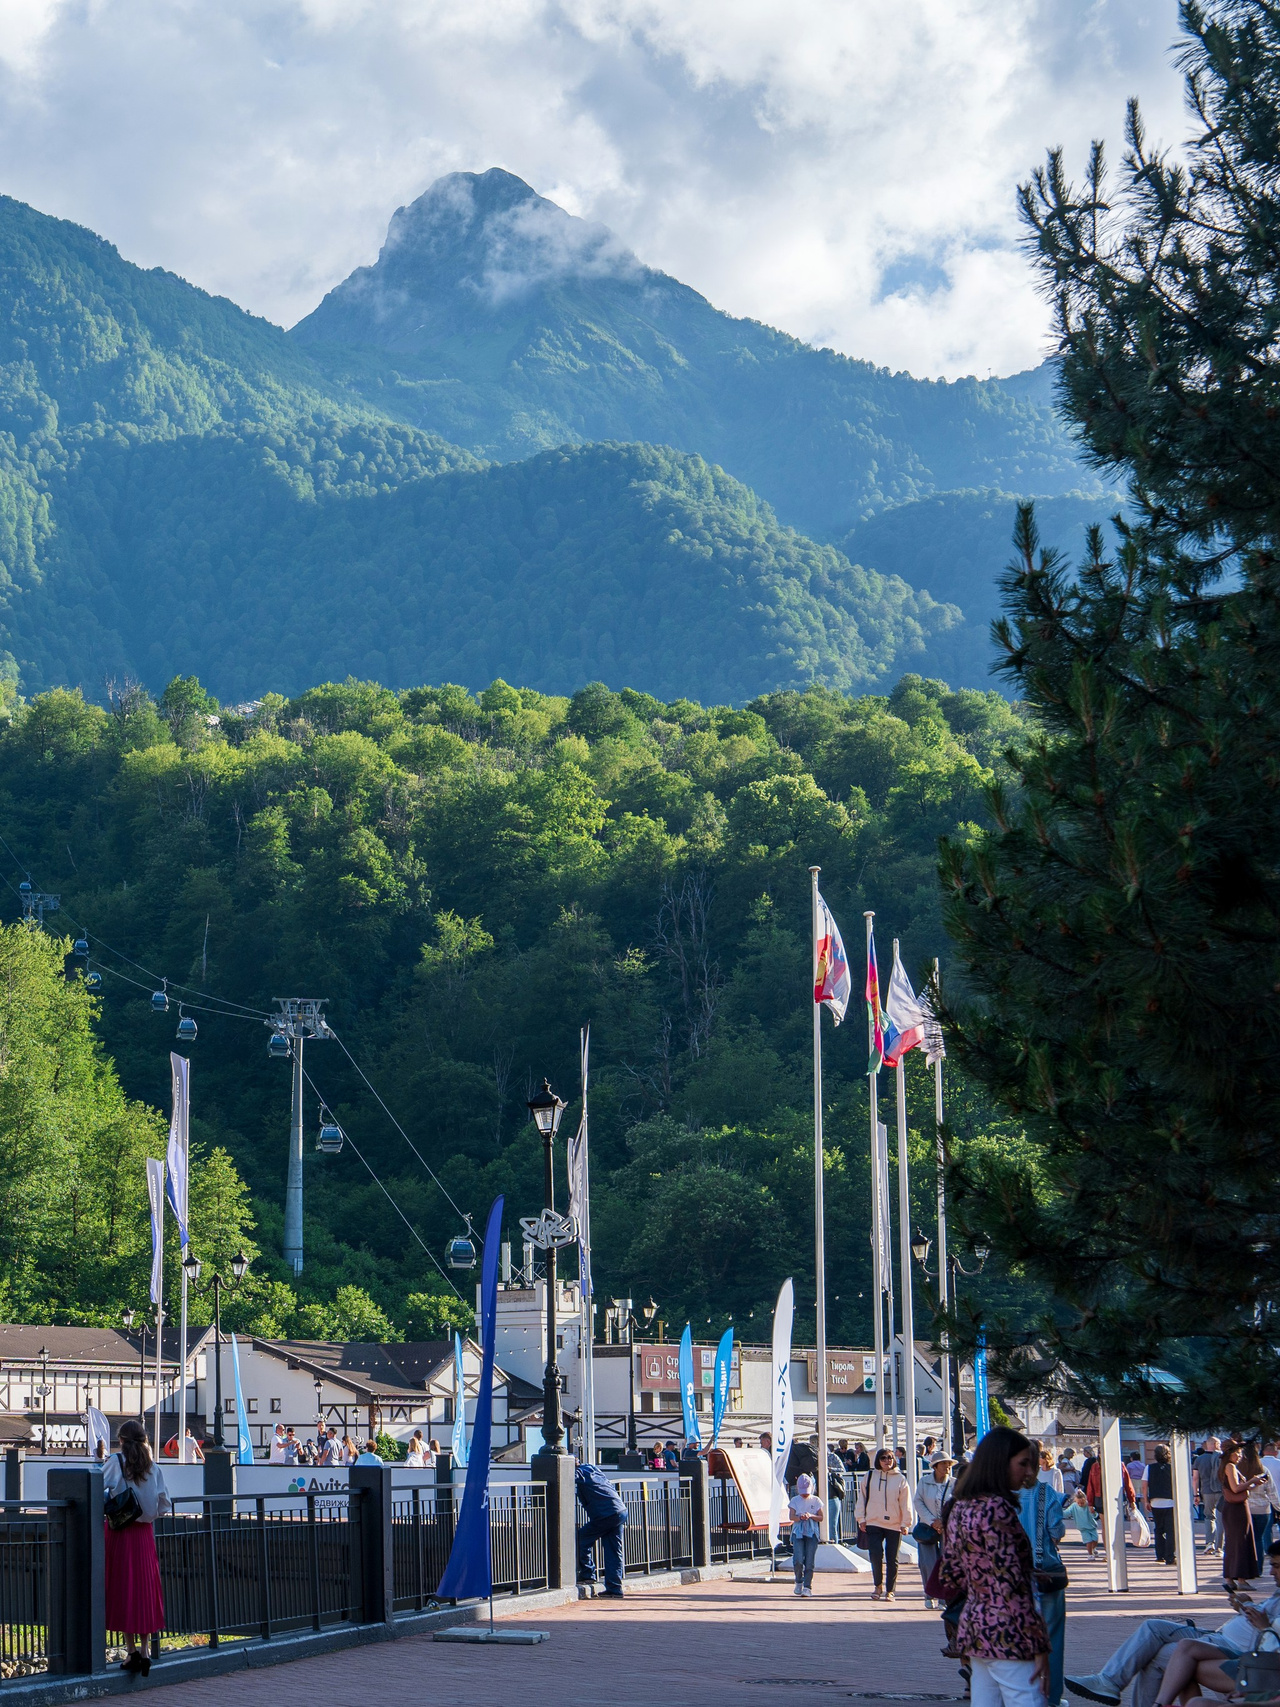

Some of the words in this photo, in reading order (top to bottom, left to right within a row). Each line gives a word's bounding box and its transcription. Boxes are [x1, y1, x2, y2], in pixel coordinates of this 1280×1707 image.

[666, 1355, 680, 1368] Стр
[831, 1361, 855, 1372] Тироль
[666, 1369, 680, 1380] Stre
[831, 1374, 848, 1385] Tirol
[30, 1424, 87, 1442] SPORTA
[314, 1499, 350, 1508] едвижи
